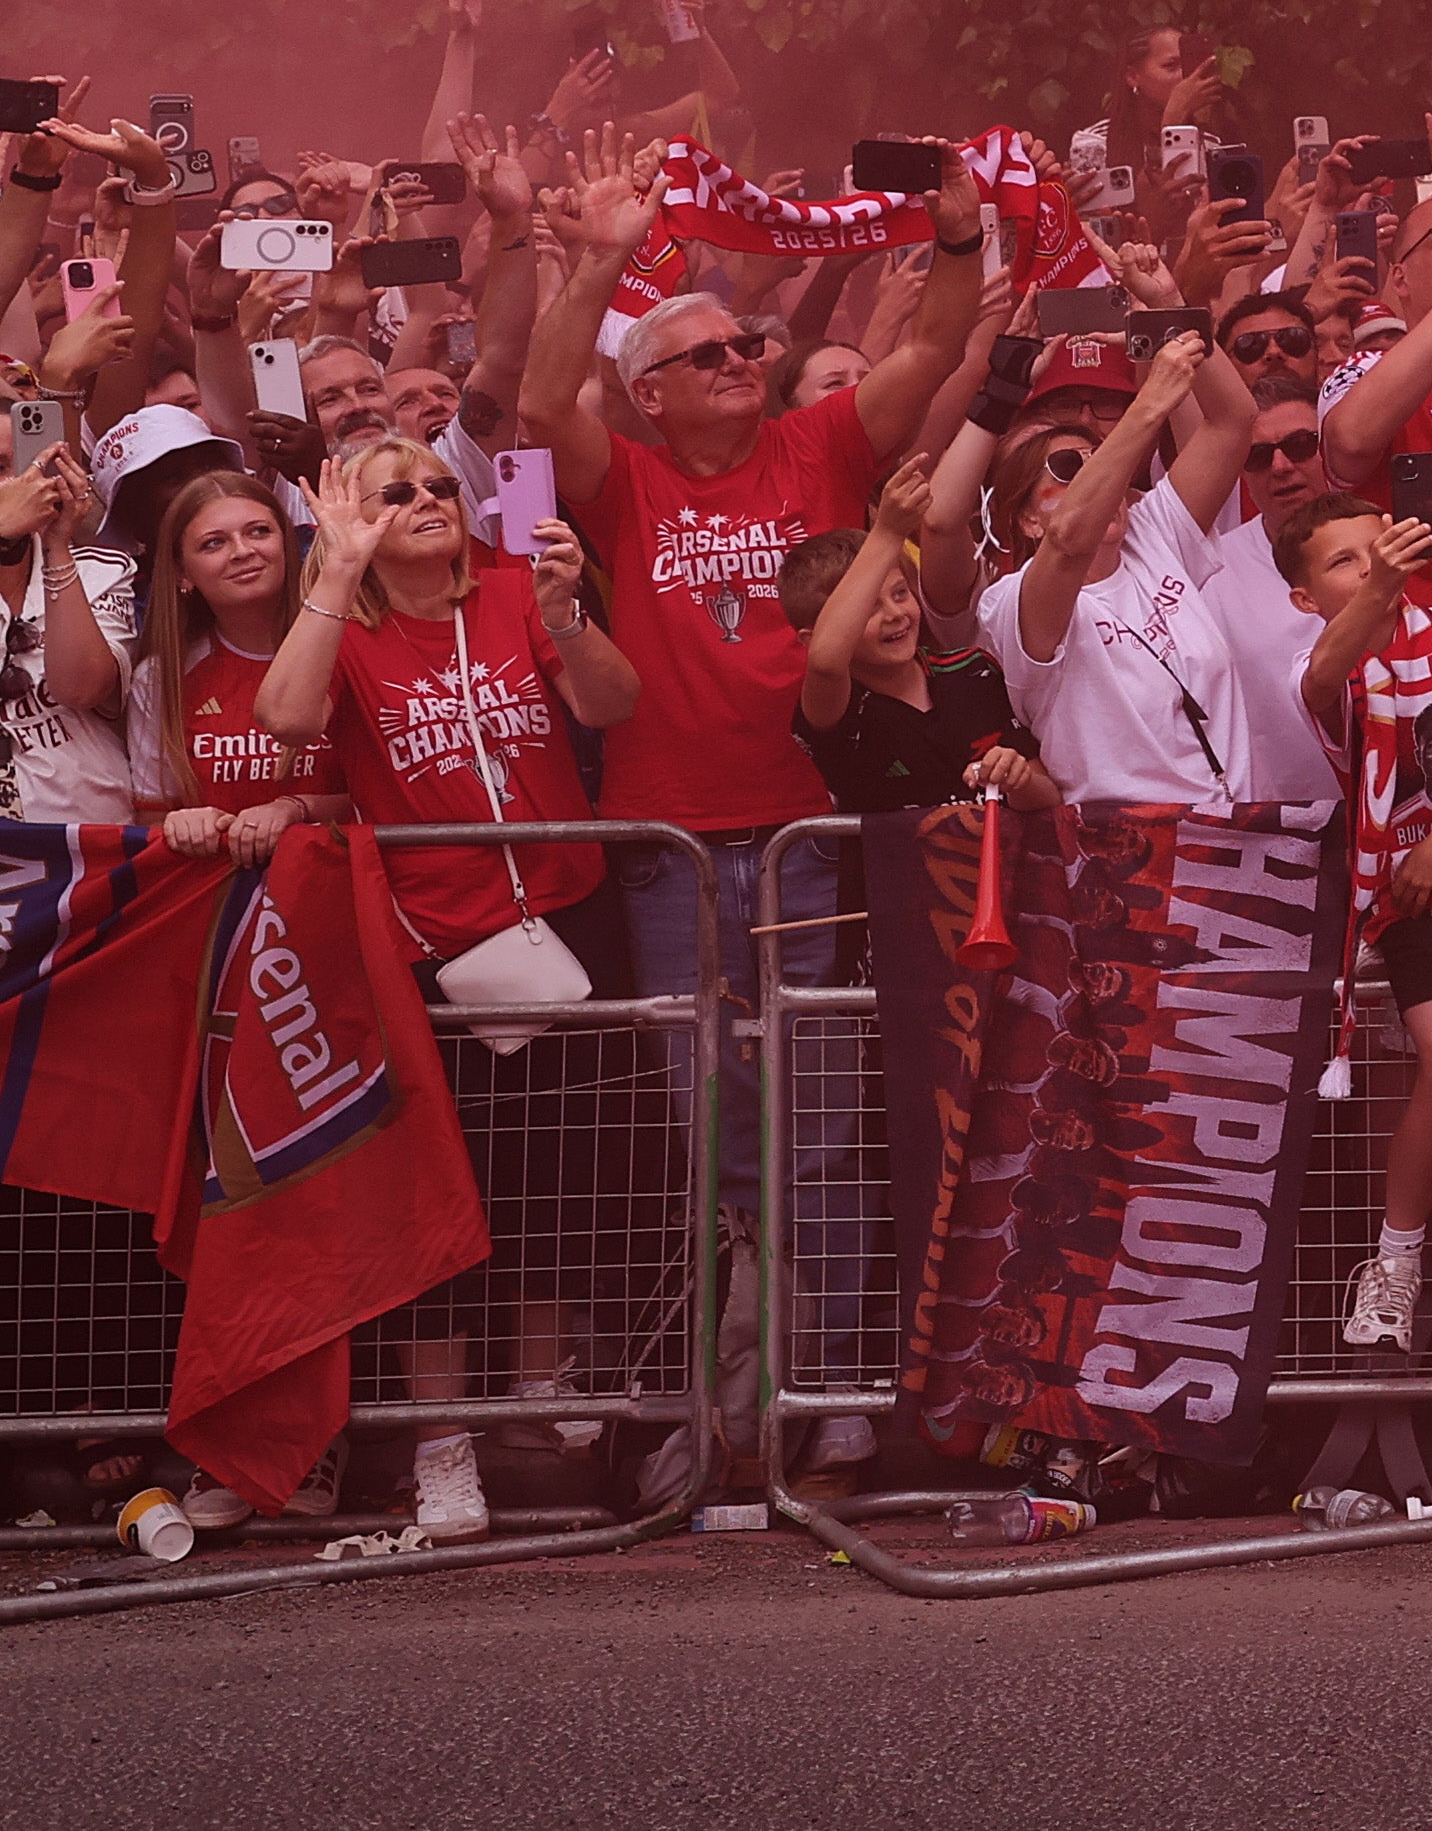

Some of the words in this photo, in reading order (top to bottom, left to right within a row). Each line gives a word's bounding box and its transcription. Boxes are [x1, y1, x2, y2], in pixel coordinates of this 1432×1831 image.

[770, 221, 887, 249] 2025/26
[1038, 236, 1089, 289] HAMPIONS
[96, 421, 140, 470] CHAMPIONS
[746, 584, 780, 599] 2026
[212, 759, 243, 784] FLY
[249, 755, 315, 781] BEER
[436, 754, 463, 777] 202
[1396, 821, 1432, 846] BUK
[250, 894, 361, 1112] senal
[934, 983, 982, 1085] OF
